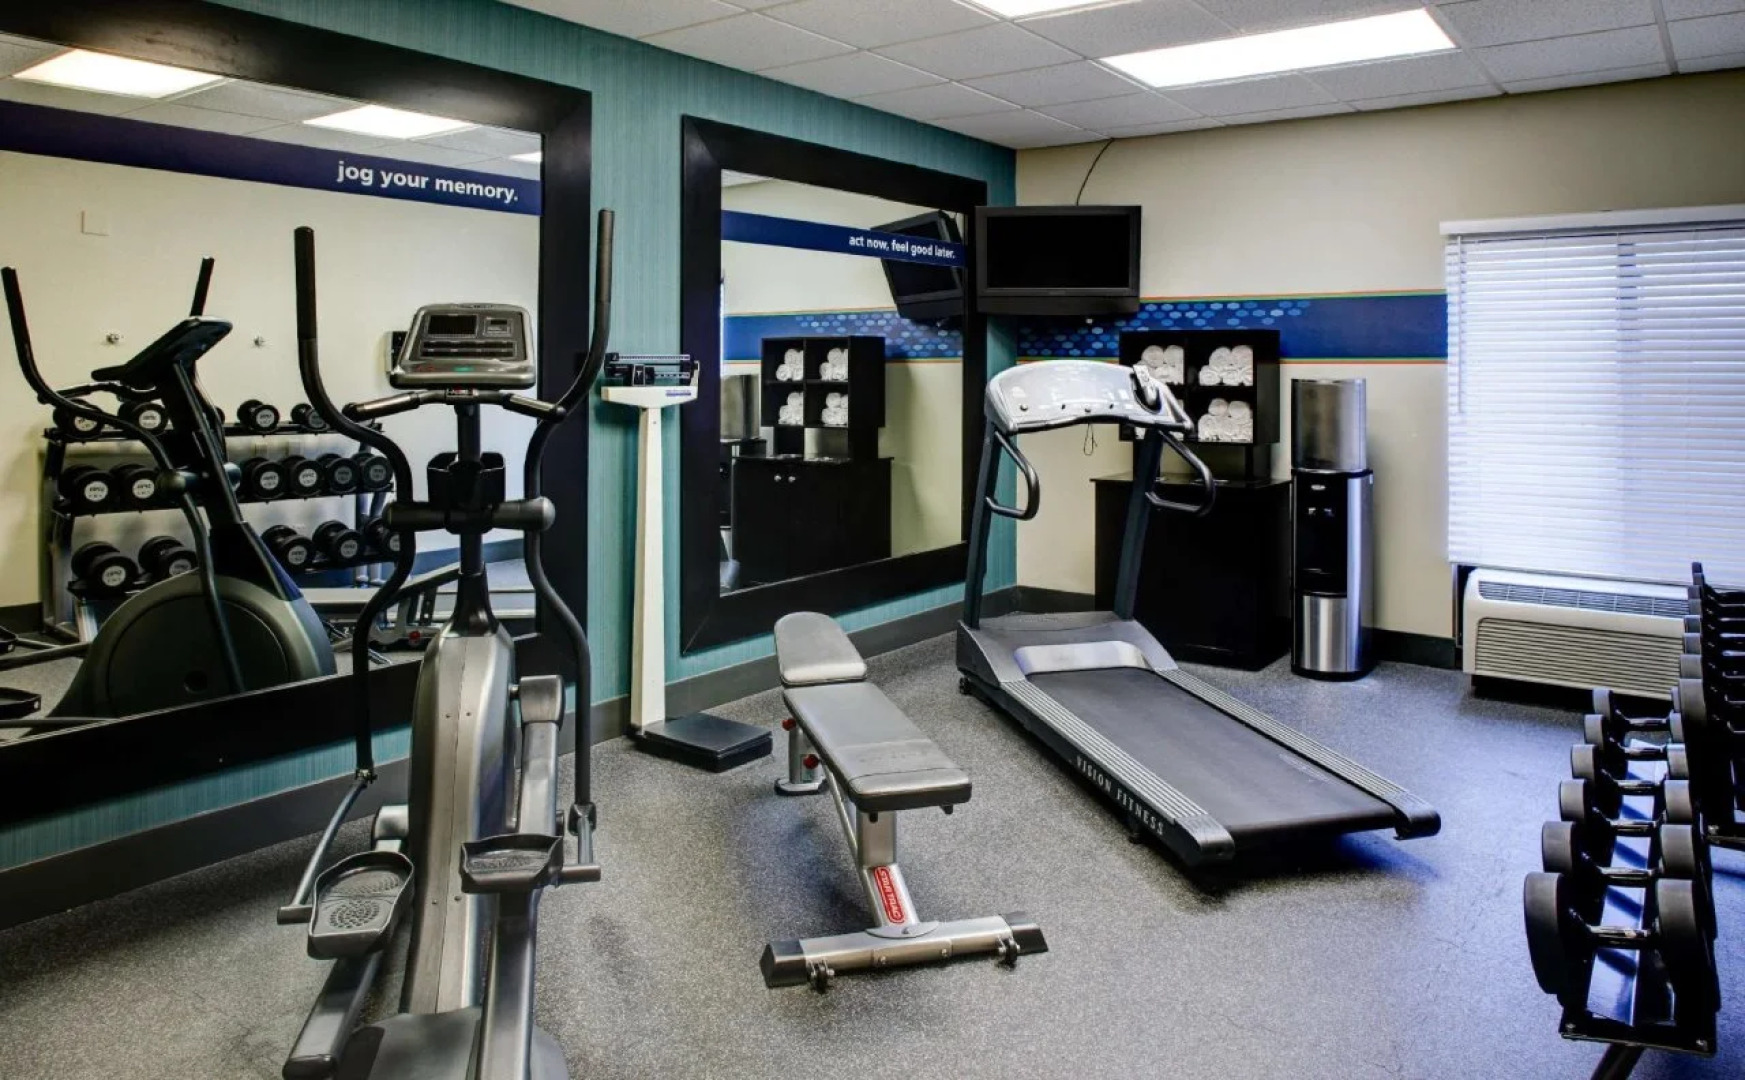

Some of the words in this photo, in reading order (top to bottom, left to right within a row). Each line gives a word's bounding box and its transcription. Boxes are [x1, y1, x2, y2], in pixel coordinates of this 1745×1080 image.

[336, 160, 373, 186] jog
[380, 169, 429, 188] your
[435, 177, 519, 204] memory.
[848, 235, 864, 247] act
[867, 238, 889, 251] now,
[891, 239, 909, 253] feel
[911, 244, 933, 256] good
[934, 245, 956, 259] later.
[1076, 755, 1112, 793] VISION
[1116, 788, 1164, 836] FITNESS
